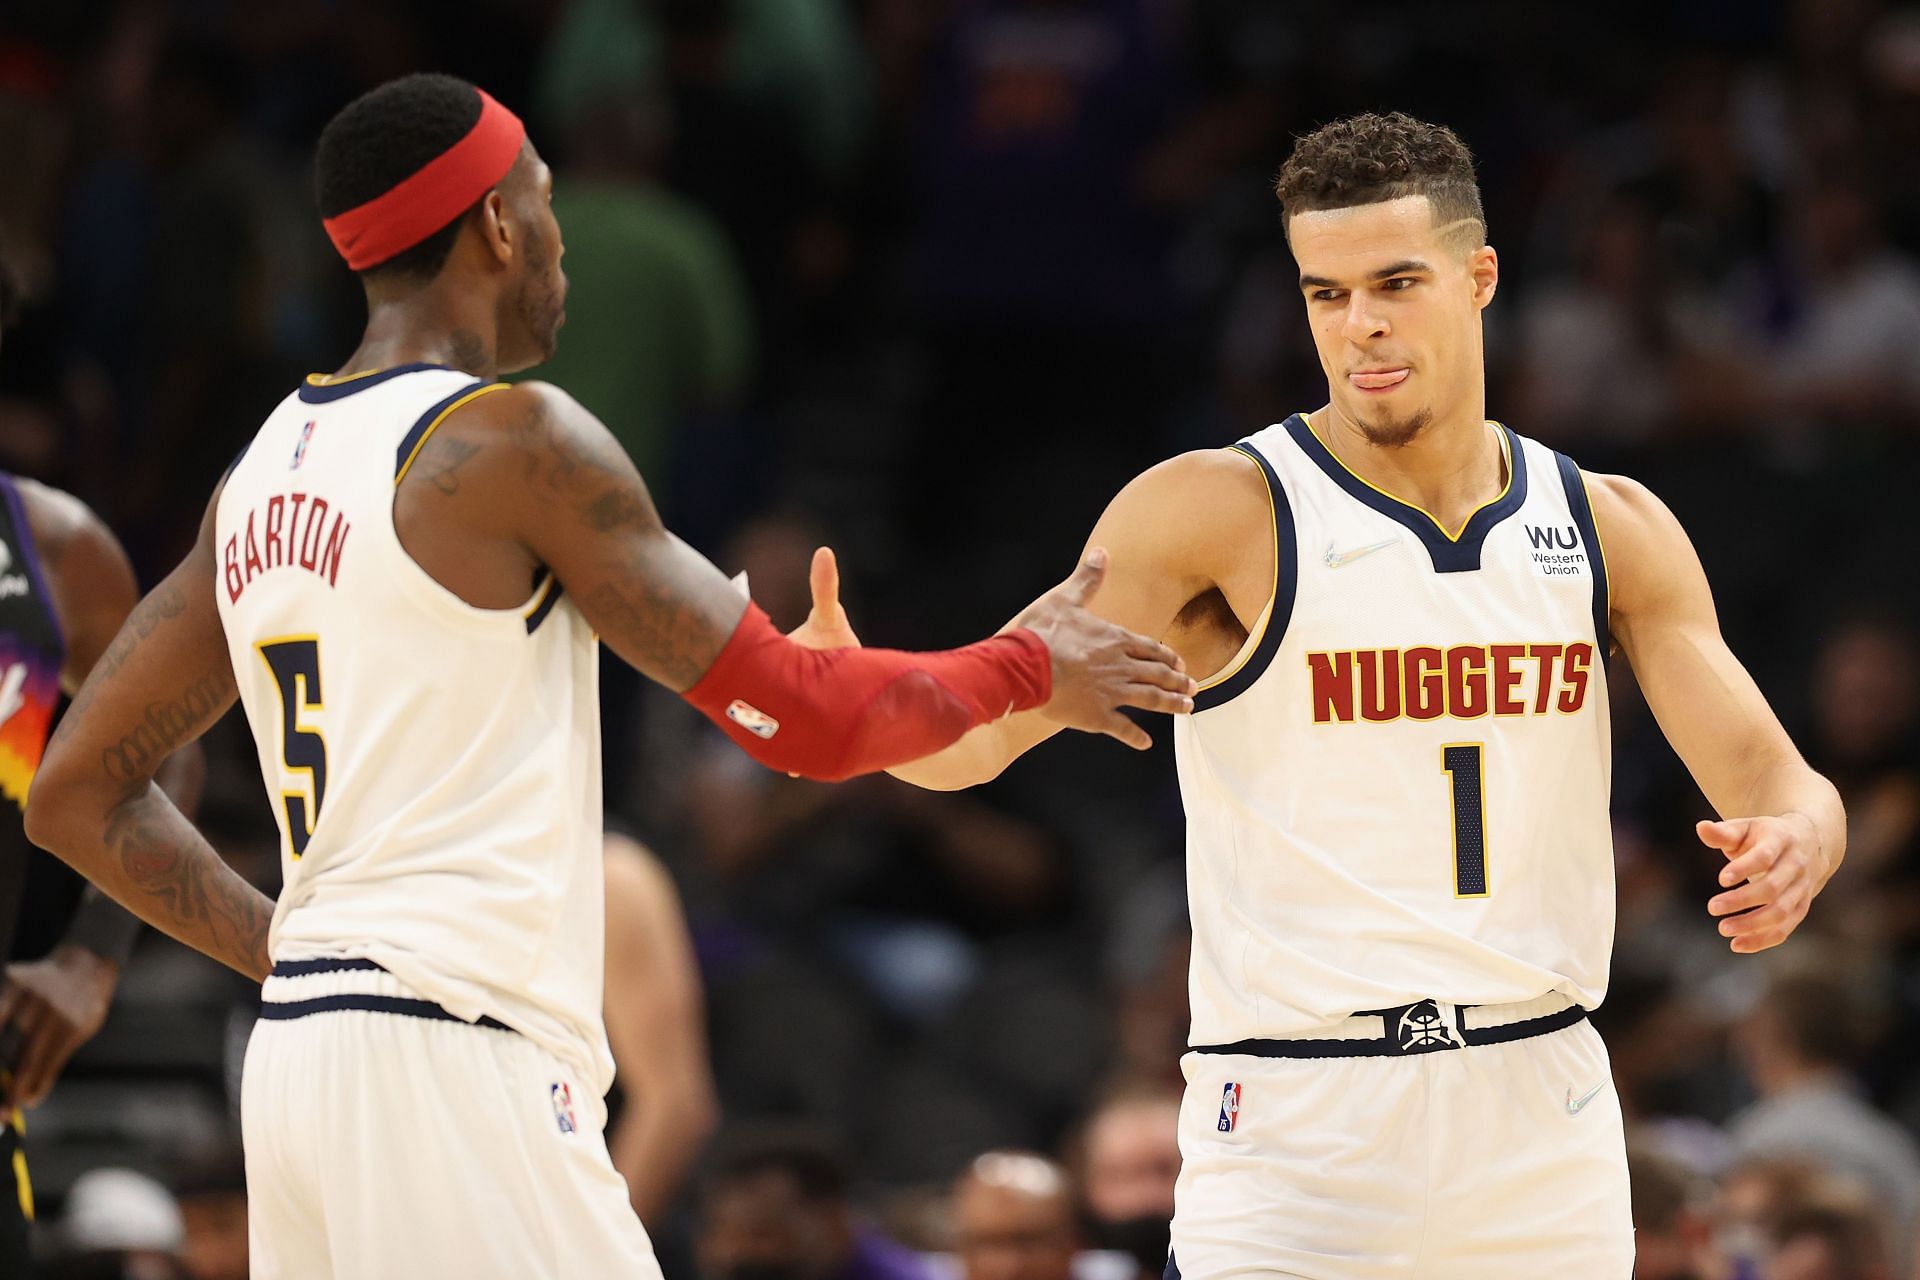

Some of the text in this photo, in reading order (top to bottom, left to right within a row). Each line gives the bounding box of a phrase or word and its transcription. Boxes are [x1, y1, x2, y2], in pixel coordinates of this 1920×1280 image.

[225, 493, 351, 606] BARTON
[1525, 525, 1578, 549] WU
[1531, 552, 1584, 563] Western
[1543, 564, 1579, 575] Union
[1306, 641, 1593, 724] NUGGETS
[253, 634, 328, 861] 5
[1440, 742, 1490, 898] 1
